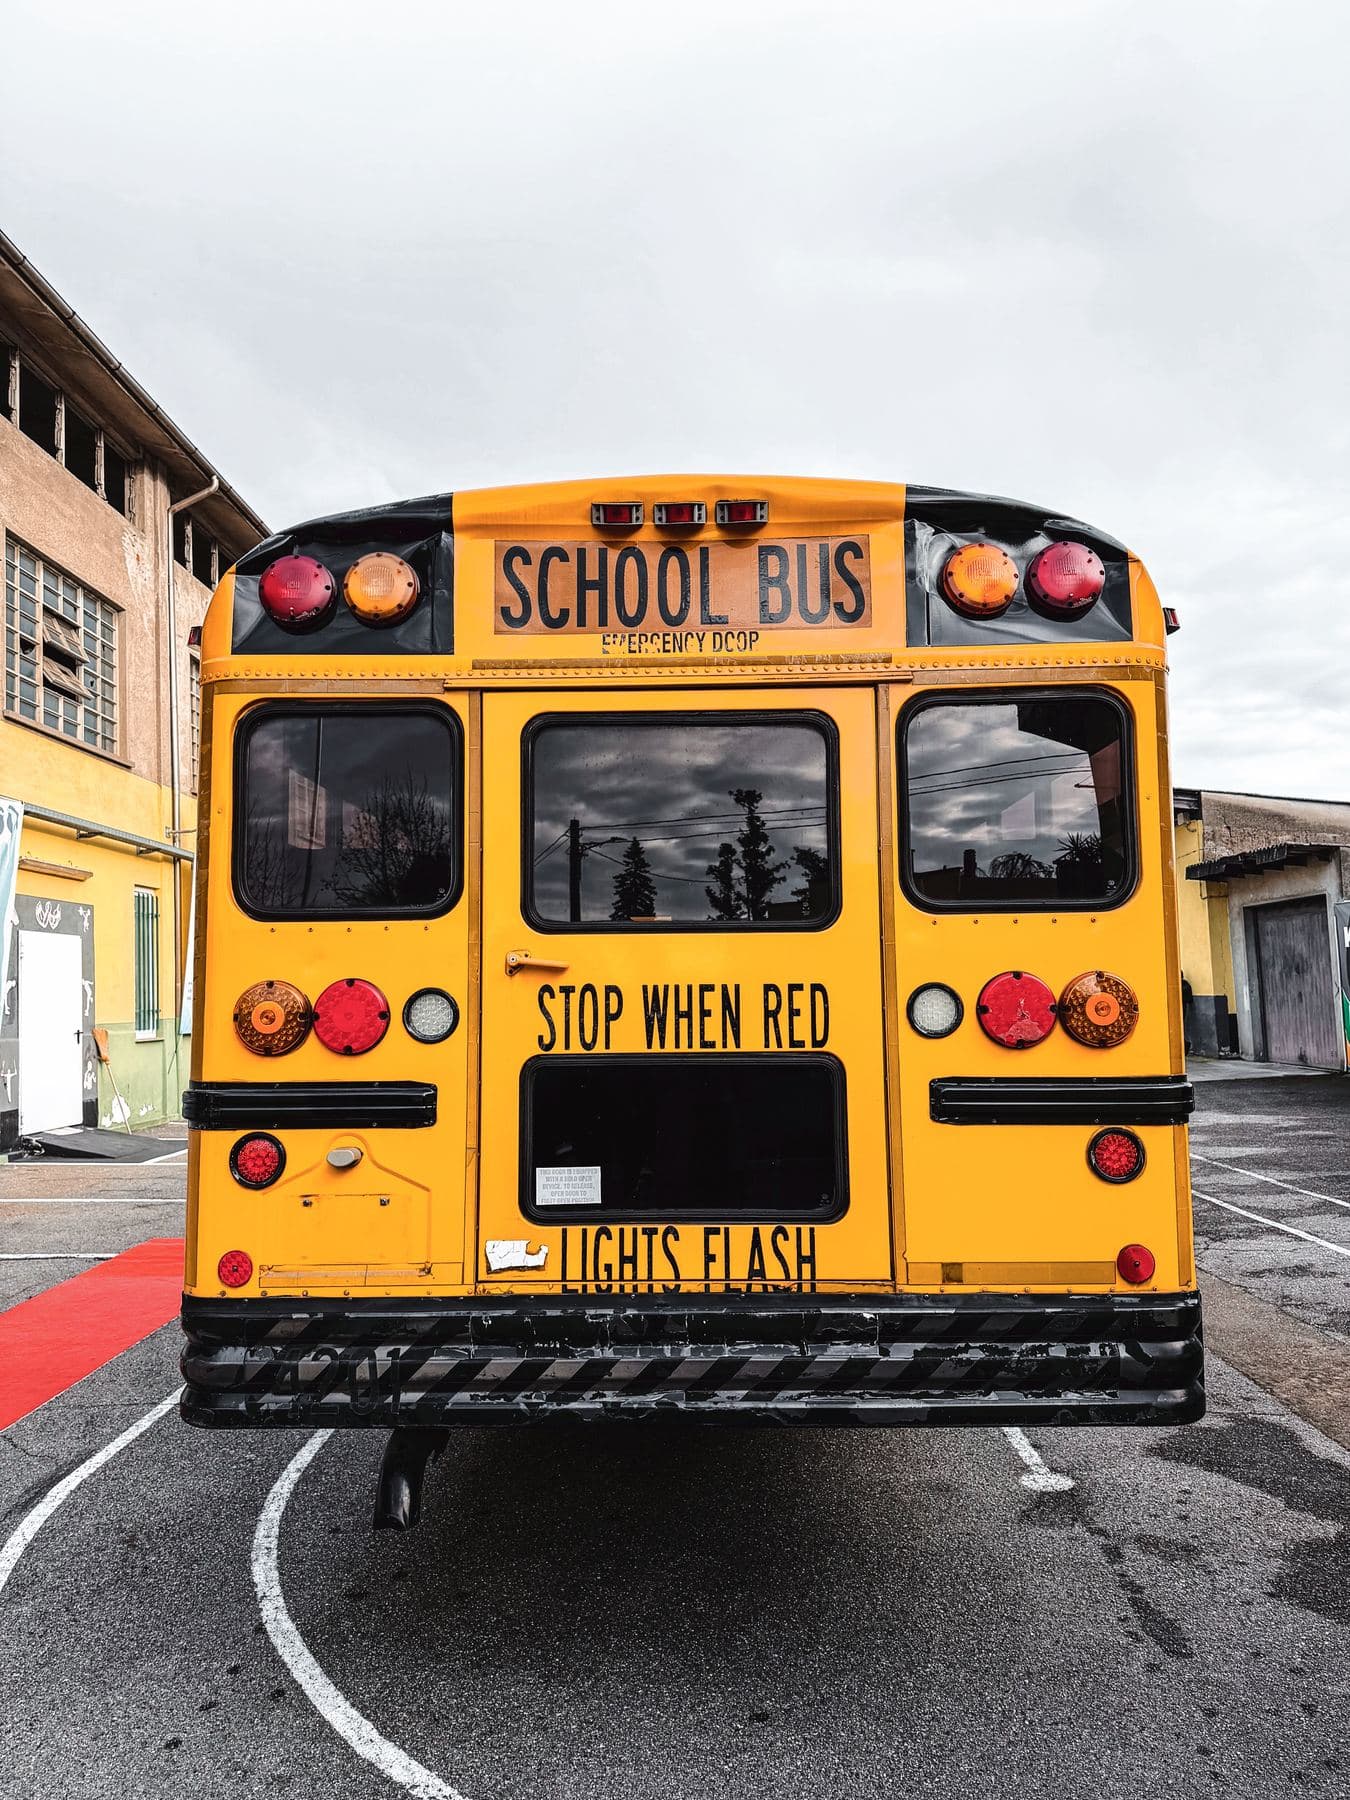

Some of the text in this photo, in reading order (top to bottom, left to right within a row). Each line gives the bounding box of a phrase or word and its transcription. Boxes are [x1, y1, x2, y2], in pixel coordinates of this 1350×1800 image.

[500, 541, 866, 629] SCHOOL BUS
[537, 982, 830, 1051] STOP WHEN RED
[561, 1225, 816, 1294] LIGHTS FLASH
